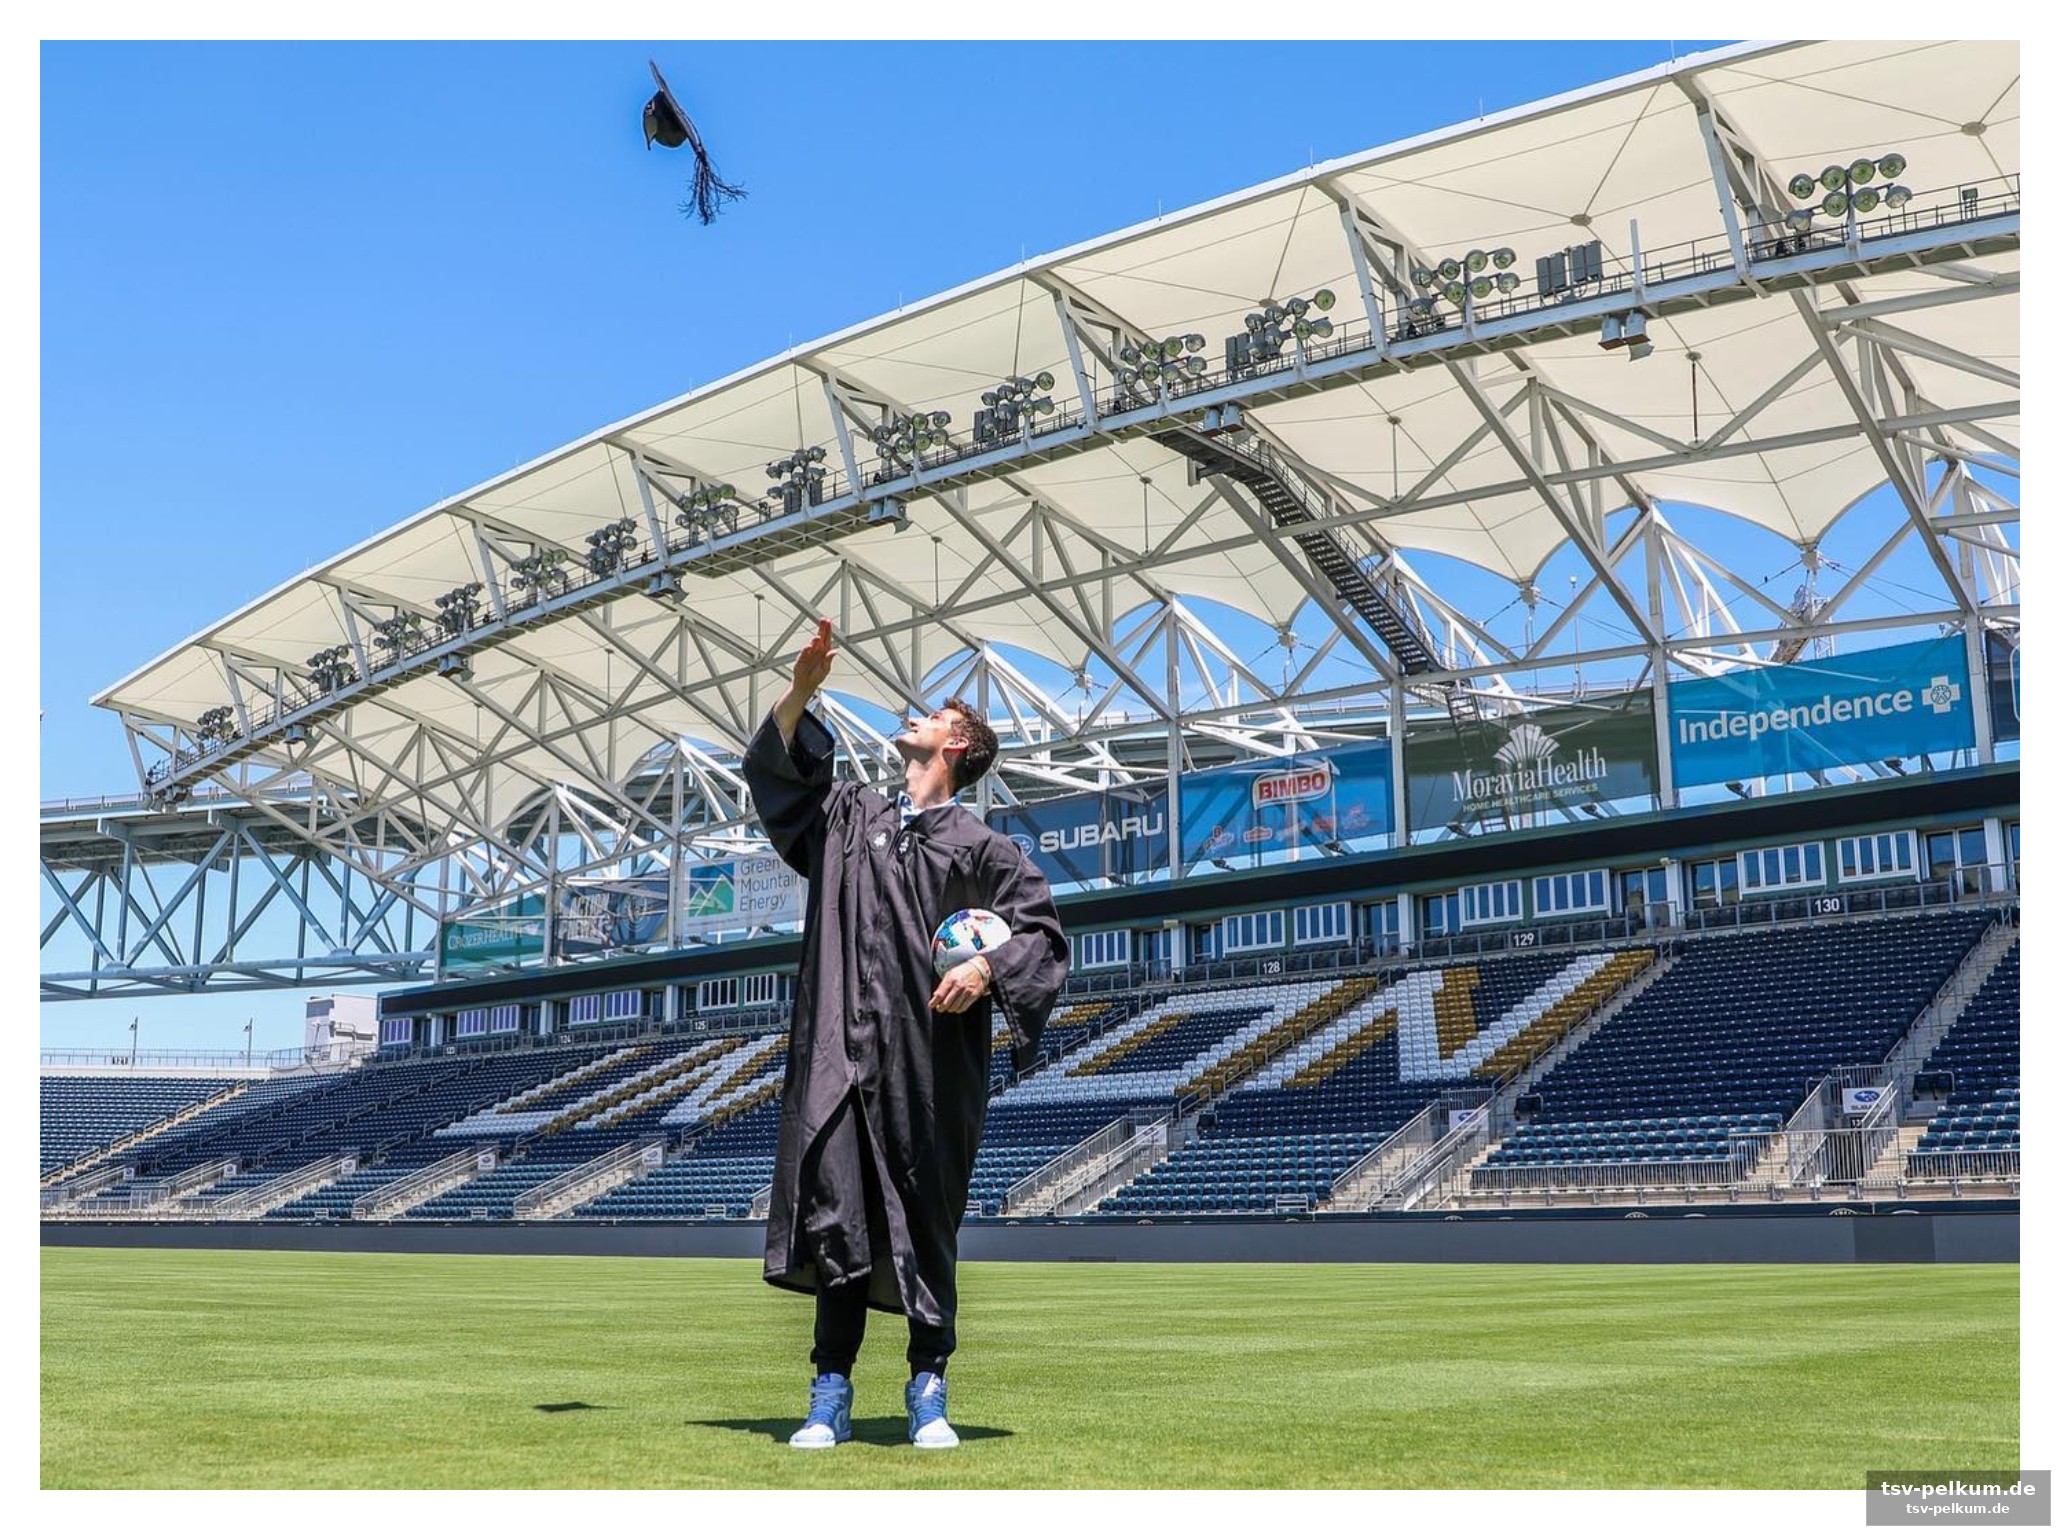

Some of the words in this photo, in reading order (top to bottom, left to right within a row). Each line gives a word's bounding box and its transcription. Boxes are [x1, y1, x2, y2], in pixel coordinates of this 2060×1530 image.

[1679, 689, 1913, 745] Independence
[1258, 770, 1326, 801] BIMBO
[1452, 746, 1609, 802] MoraviaHealth
[1462, 802, 1490, 813] HOME
[1491, 791, 1550, 809] HEALTHCARE
[1553, 782, 1599, 797] SERVICES
[1039, 812, 1164, 854] SUBARU
[740, 856, 780, 876] Green
[740, 892, 787, 912] Energy
[1814, 897, 1840, 914] 130
[1513, 932, 1535, 948] 129
[1263, 961, 1281, 974] 128
